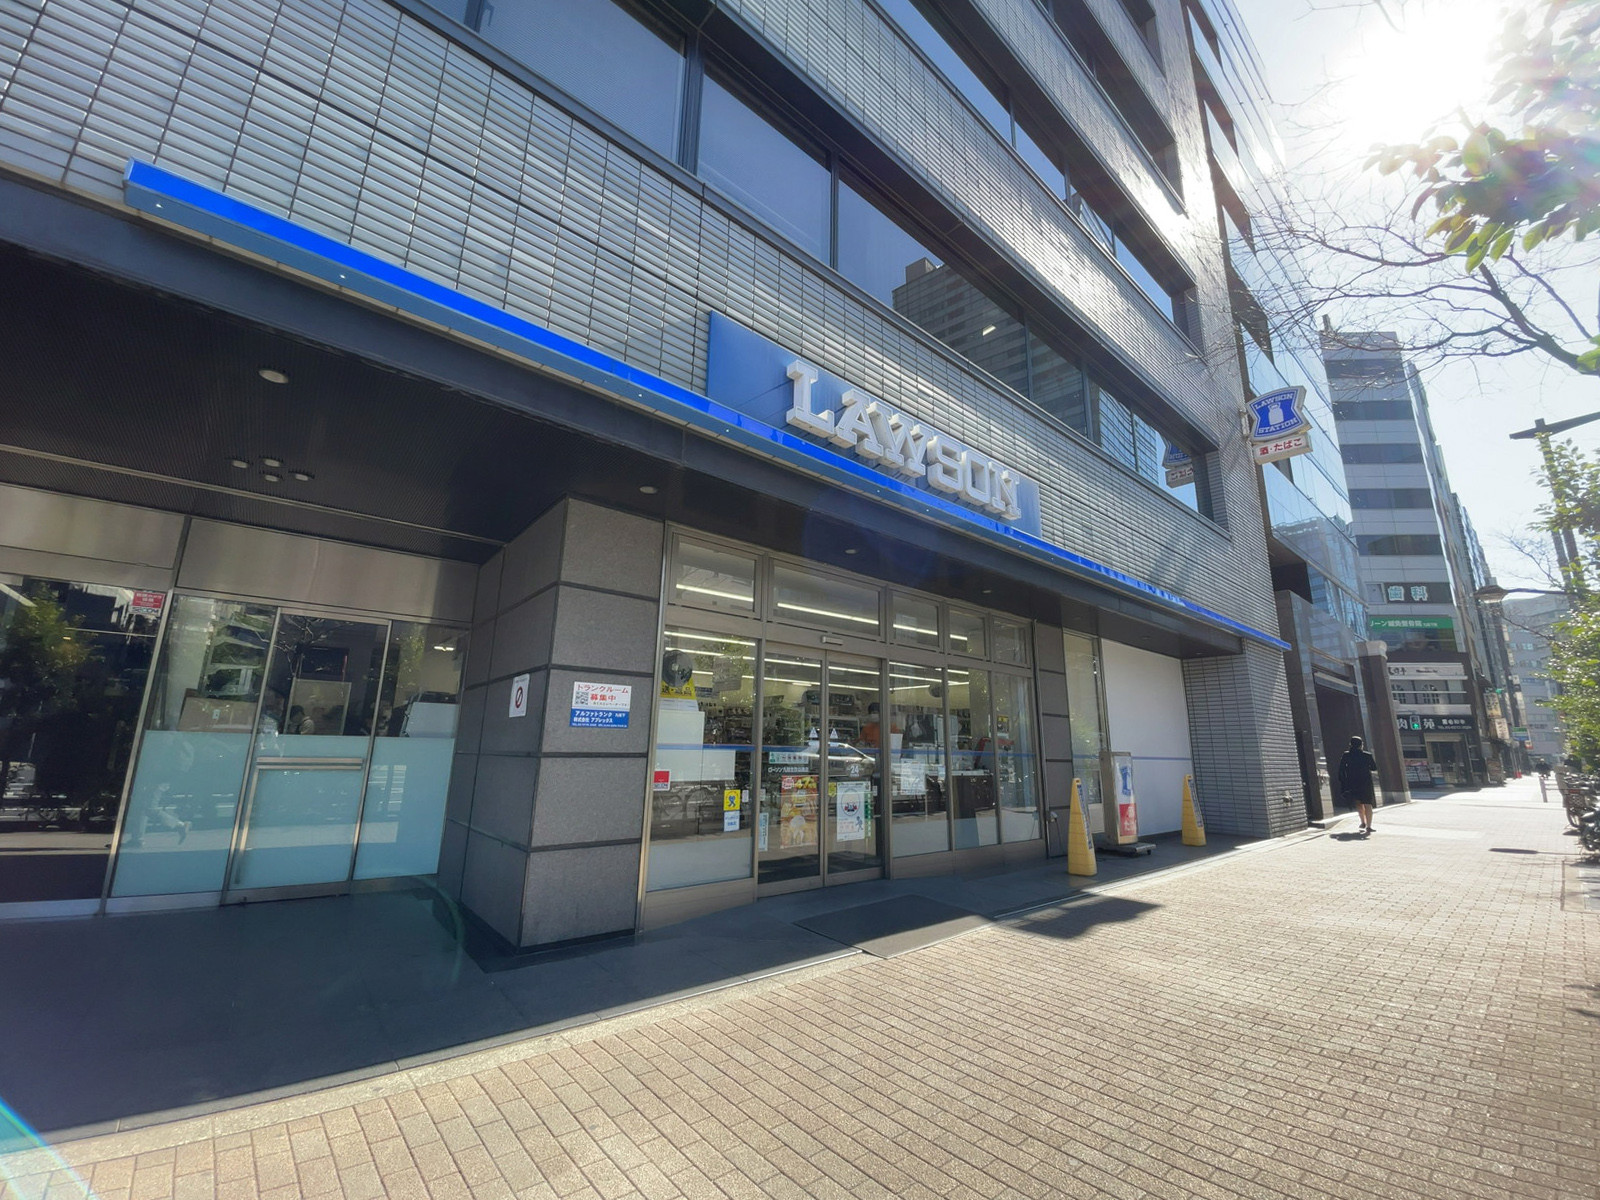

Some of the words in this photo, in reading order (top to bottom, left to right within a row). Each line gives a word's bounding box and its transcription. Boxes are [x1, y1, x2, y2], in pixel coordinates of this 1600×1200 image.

[1254, 393, 1294, 410] LAWSON
[1258, 418, 1298, 434] STATION
[786, 359, 1021, 521] LAWSON
[1387, 585, 1429, 601] 歯科
[577, 684, 629, 694] トランクルーム
[590, 693, 617, 702] 募集中
